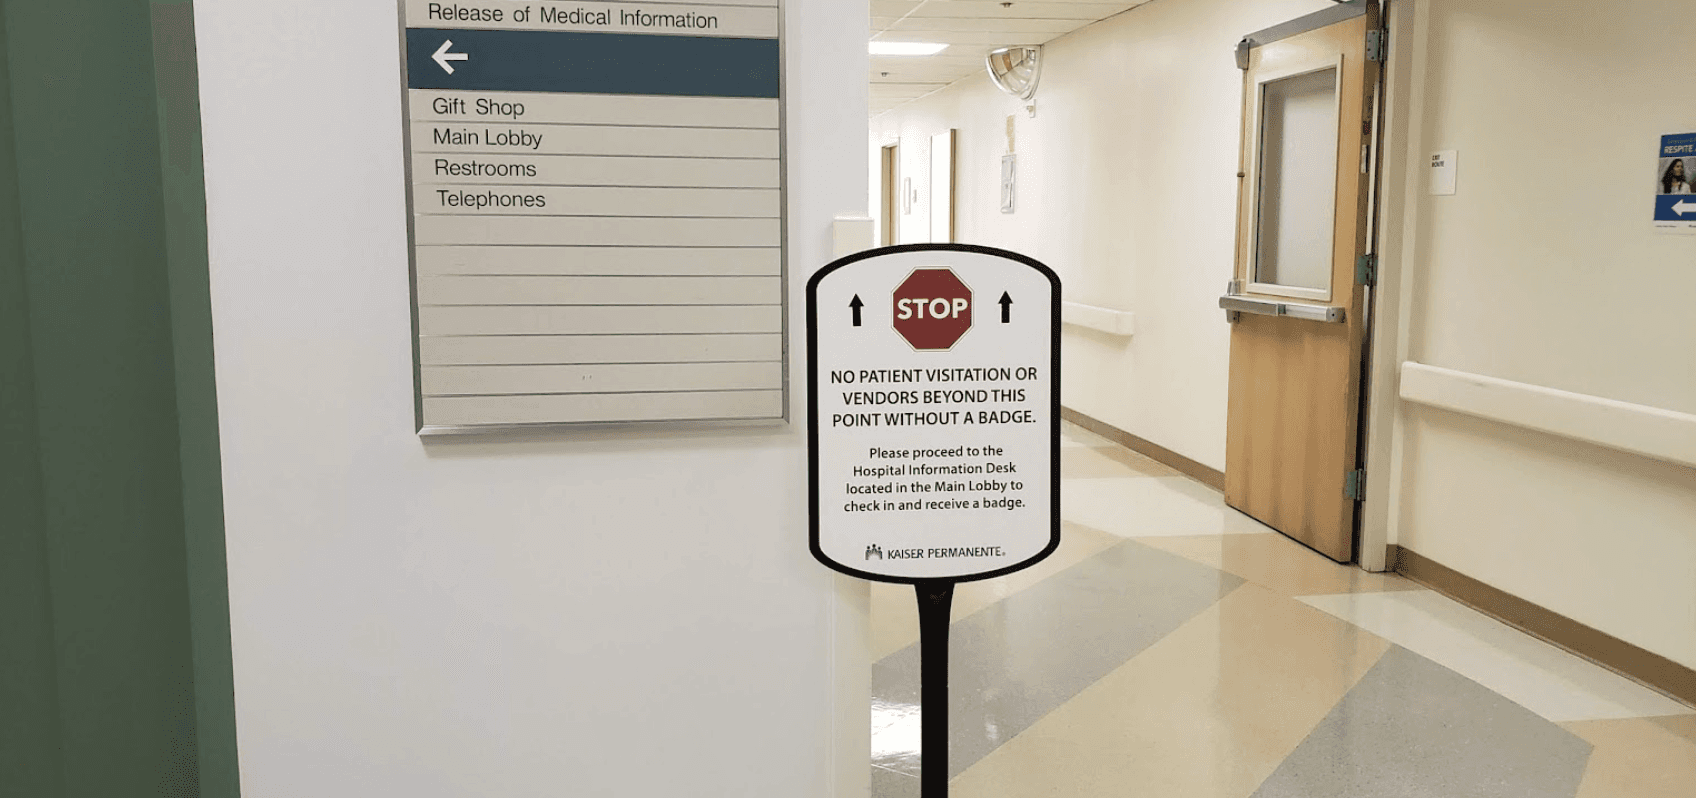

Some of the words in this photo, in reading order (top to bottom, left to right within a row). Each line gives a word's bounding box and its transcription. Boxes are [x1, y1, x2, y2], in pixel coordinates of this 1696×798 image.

[428, 2, 504, 22] Release
[512, 5, 531, 23] of
[540, 5, 611, 26] Medical
[620, 8, 718, 29] Information
[432, 96, 467, 115] Gift
[475, 97, 525, 119] Shop
[433, 127, 479, 146] Main
[484, 128, 543, 151] Lobby
[1664, 145, 1694, 154] RESPITE
[434, 158, 537, 178] Restrooms
[435, 189, 546, 211] Telephones
[897, 297, 969, 320] STOP
[830, 369, 856, 384] NO
[859, 368, 923, 384] PATIENT
[925, 367, 1011, 383] VISITATION
[1014, 366, 1038, 381] OR
[842, 390, 919, 406] VENDORS
[923, 389, 989, 404] BEYOND
[990, 388, 1026, 403] THIS
[832, 412, 882, 428] POINT
[883, 411, 960, 427] WITHOUT
[962, 411, 975, 425] A
[978, 409, 1037, 425] BADGE.
[869, 447, 910, 460] Please
[912, 444, 964, 461] proceed
[965, 446, 980, 458] to
[982, 444, 1004, 458] the
[853, 463, 906, 480] Hospital
[908, 463, 983, 477] Information
[985, 461, 1017, 475] Desk
[846, 481, 893, 495] located
[895, 481, 908, 494] in
[910, 480, 932, 493] the
[934, 480, 966, 493] Main
[968, 479, 1008, 494] Lobby
[1010, 480, 1024, 491] to
[843, 499, 881, 513] check
[883, 499, 895, 512] in
[897, 498, 922, 511] and
[925, 497, 970, 510] receive
[972, 500, 980, 509] a
[982, 496, 1026, 511] badge.
[887, 548, 925, 560] KAISER
